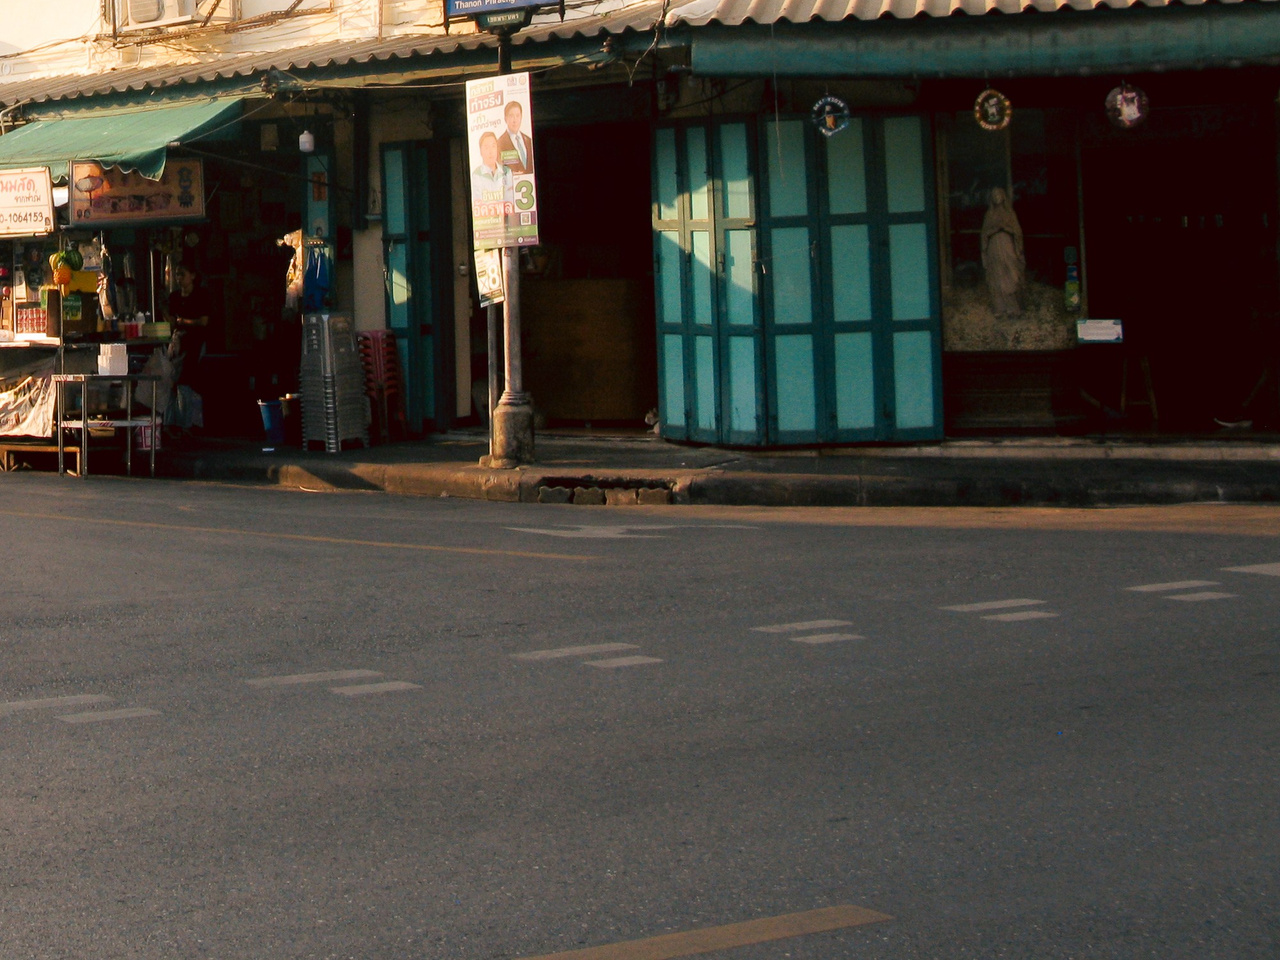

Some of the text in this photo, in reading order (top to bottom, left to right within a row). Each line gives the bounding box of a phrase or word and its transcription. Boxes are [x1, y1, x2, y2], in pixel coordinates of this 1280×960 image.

[455, 0, 482, 9] Thanon
[471, 93, 502, 111] ทำจริง
[515, 180, 535, 210] 3
[489, 264, 500, 289] 8
